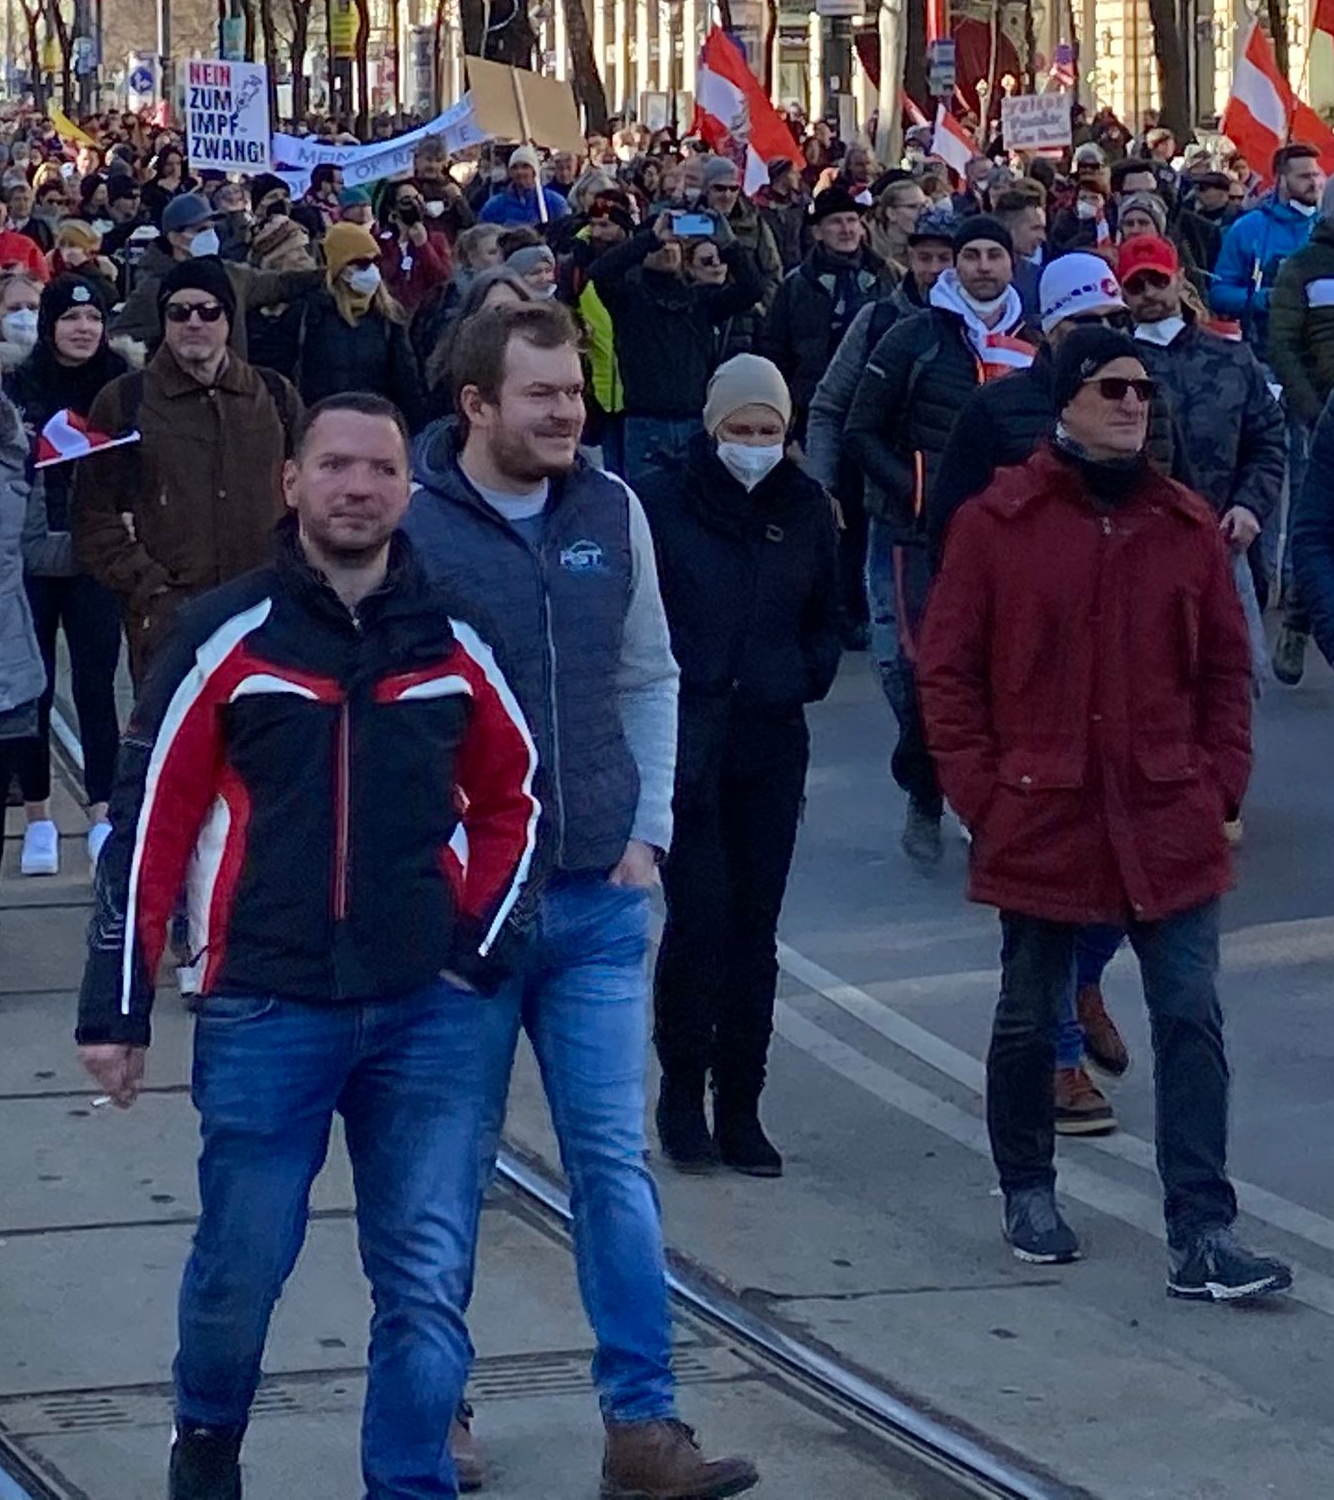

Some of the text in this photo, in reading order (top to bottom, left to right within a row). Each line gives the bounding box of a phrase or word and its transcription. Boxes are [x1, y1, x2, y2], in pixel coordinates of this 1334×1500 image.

[190, 62, 231, 88] NEIN
[190, 87, 232, 112] ZUM
[191, 111, 248, 137] IMPF-
[192, 136, 266, 164] ZWANG!
